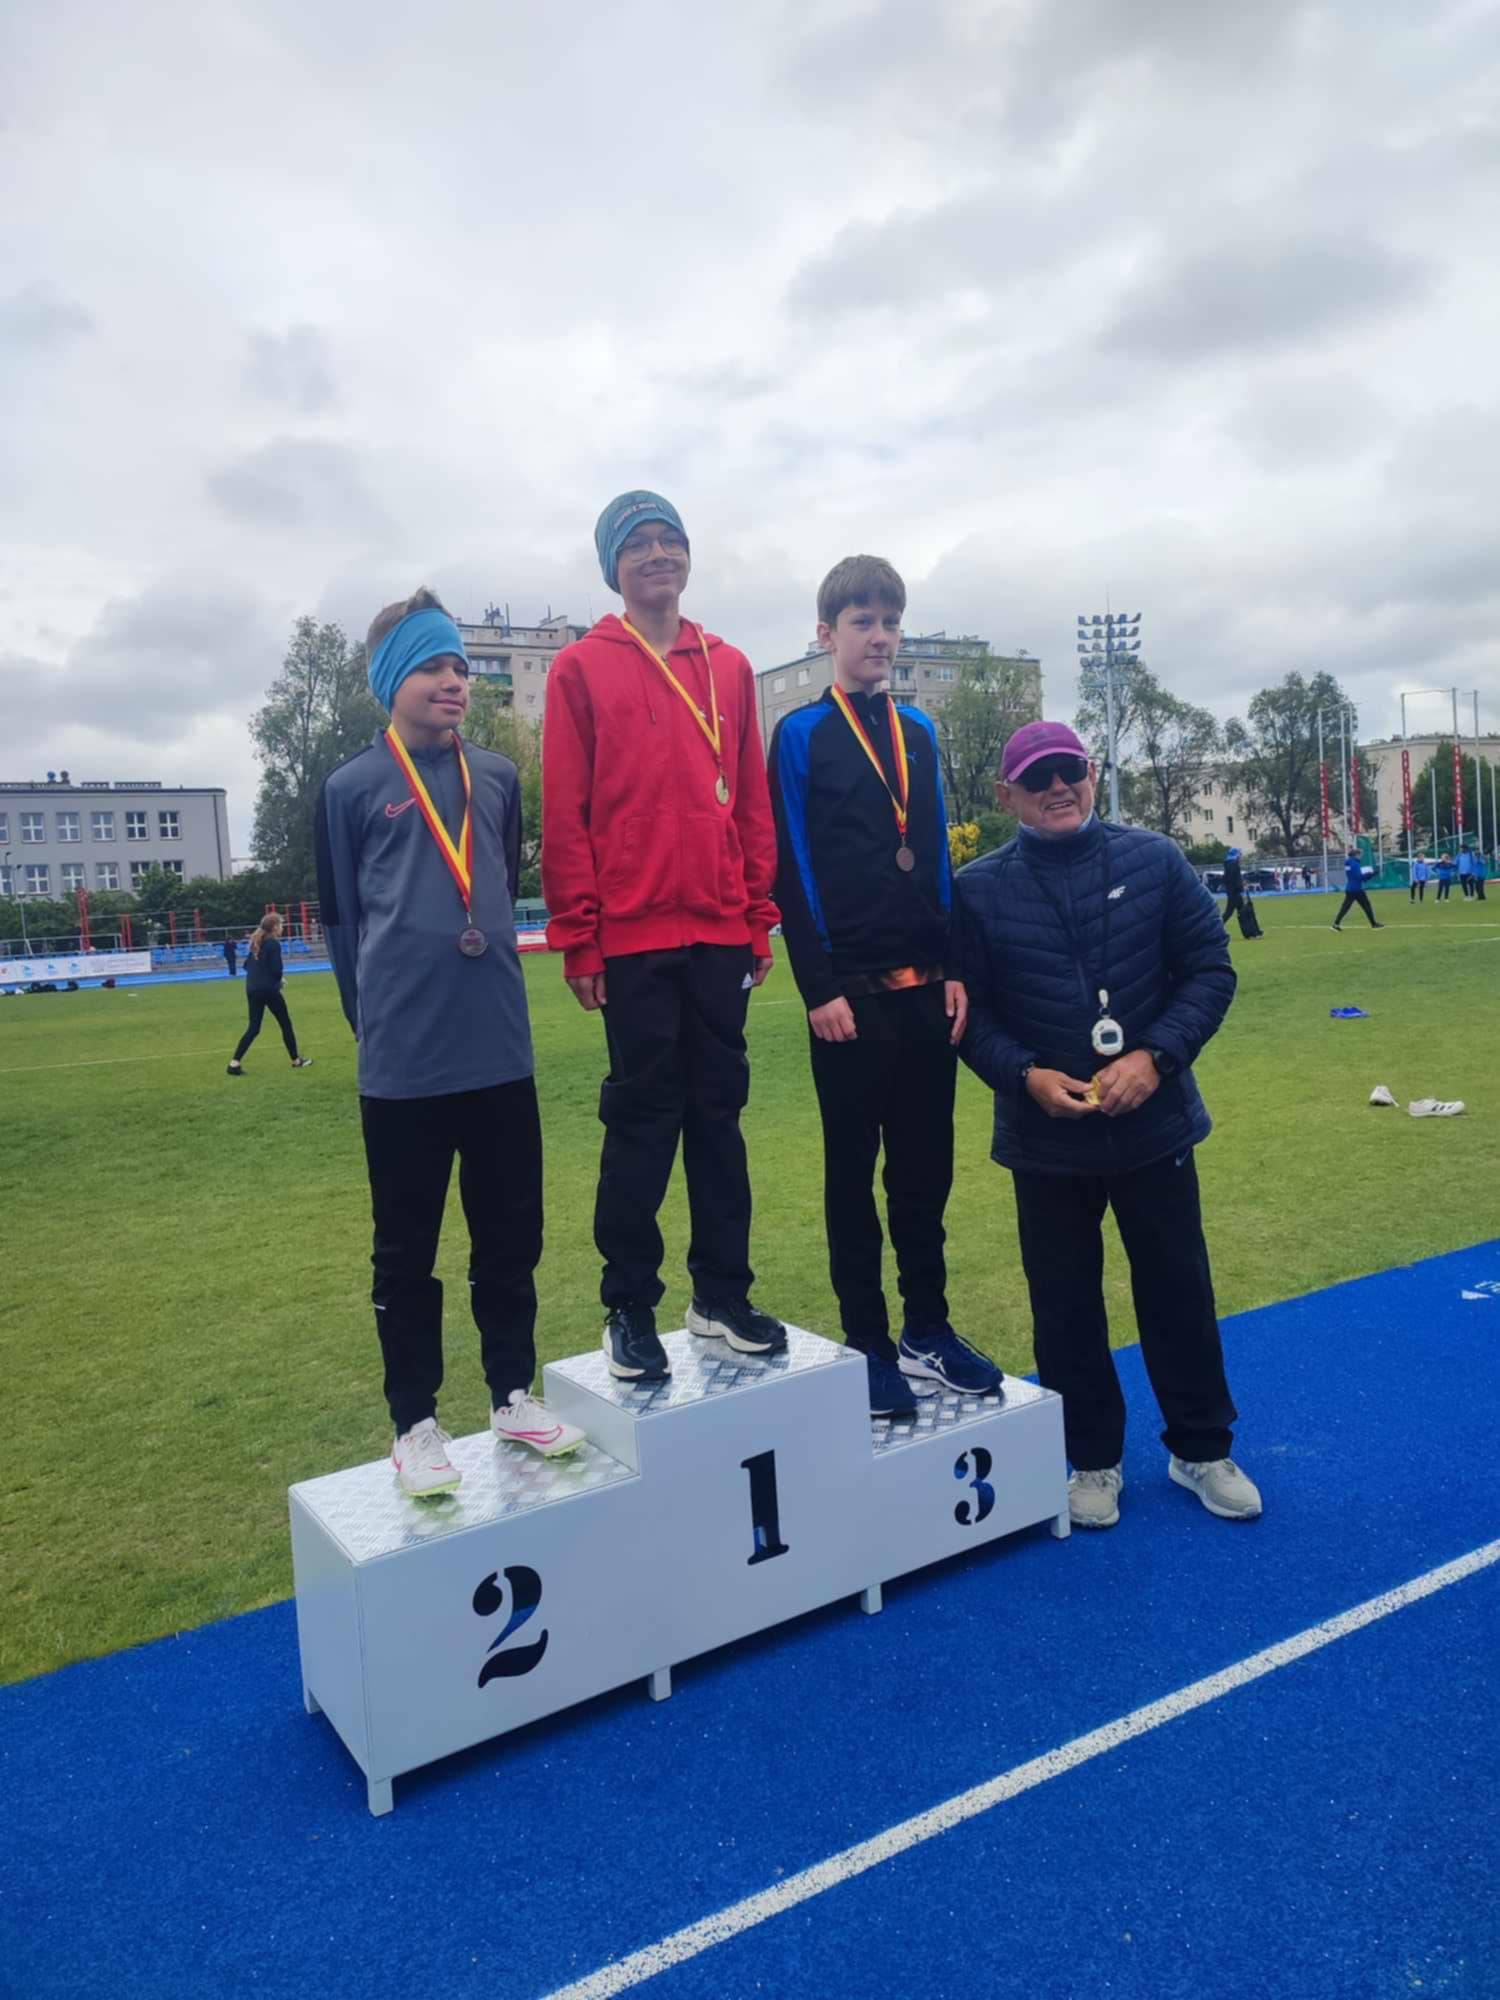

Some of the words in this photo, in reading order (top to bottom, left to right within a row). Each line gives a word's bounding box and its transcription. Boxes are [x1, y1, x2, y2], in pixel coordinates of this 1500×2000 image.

[740, 1448, 790, 1566] 1
[953, 1446, 996, 1526] 3
[472, 1564, 549, 1689] 2
